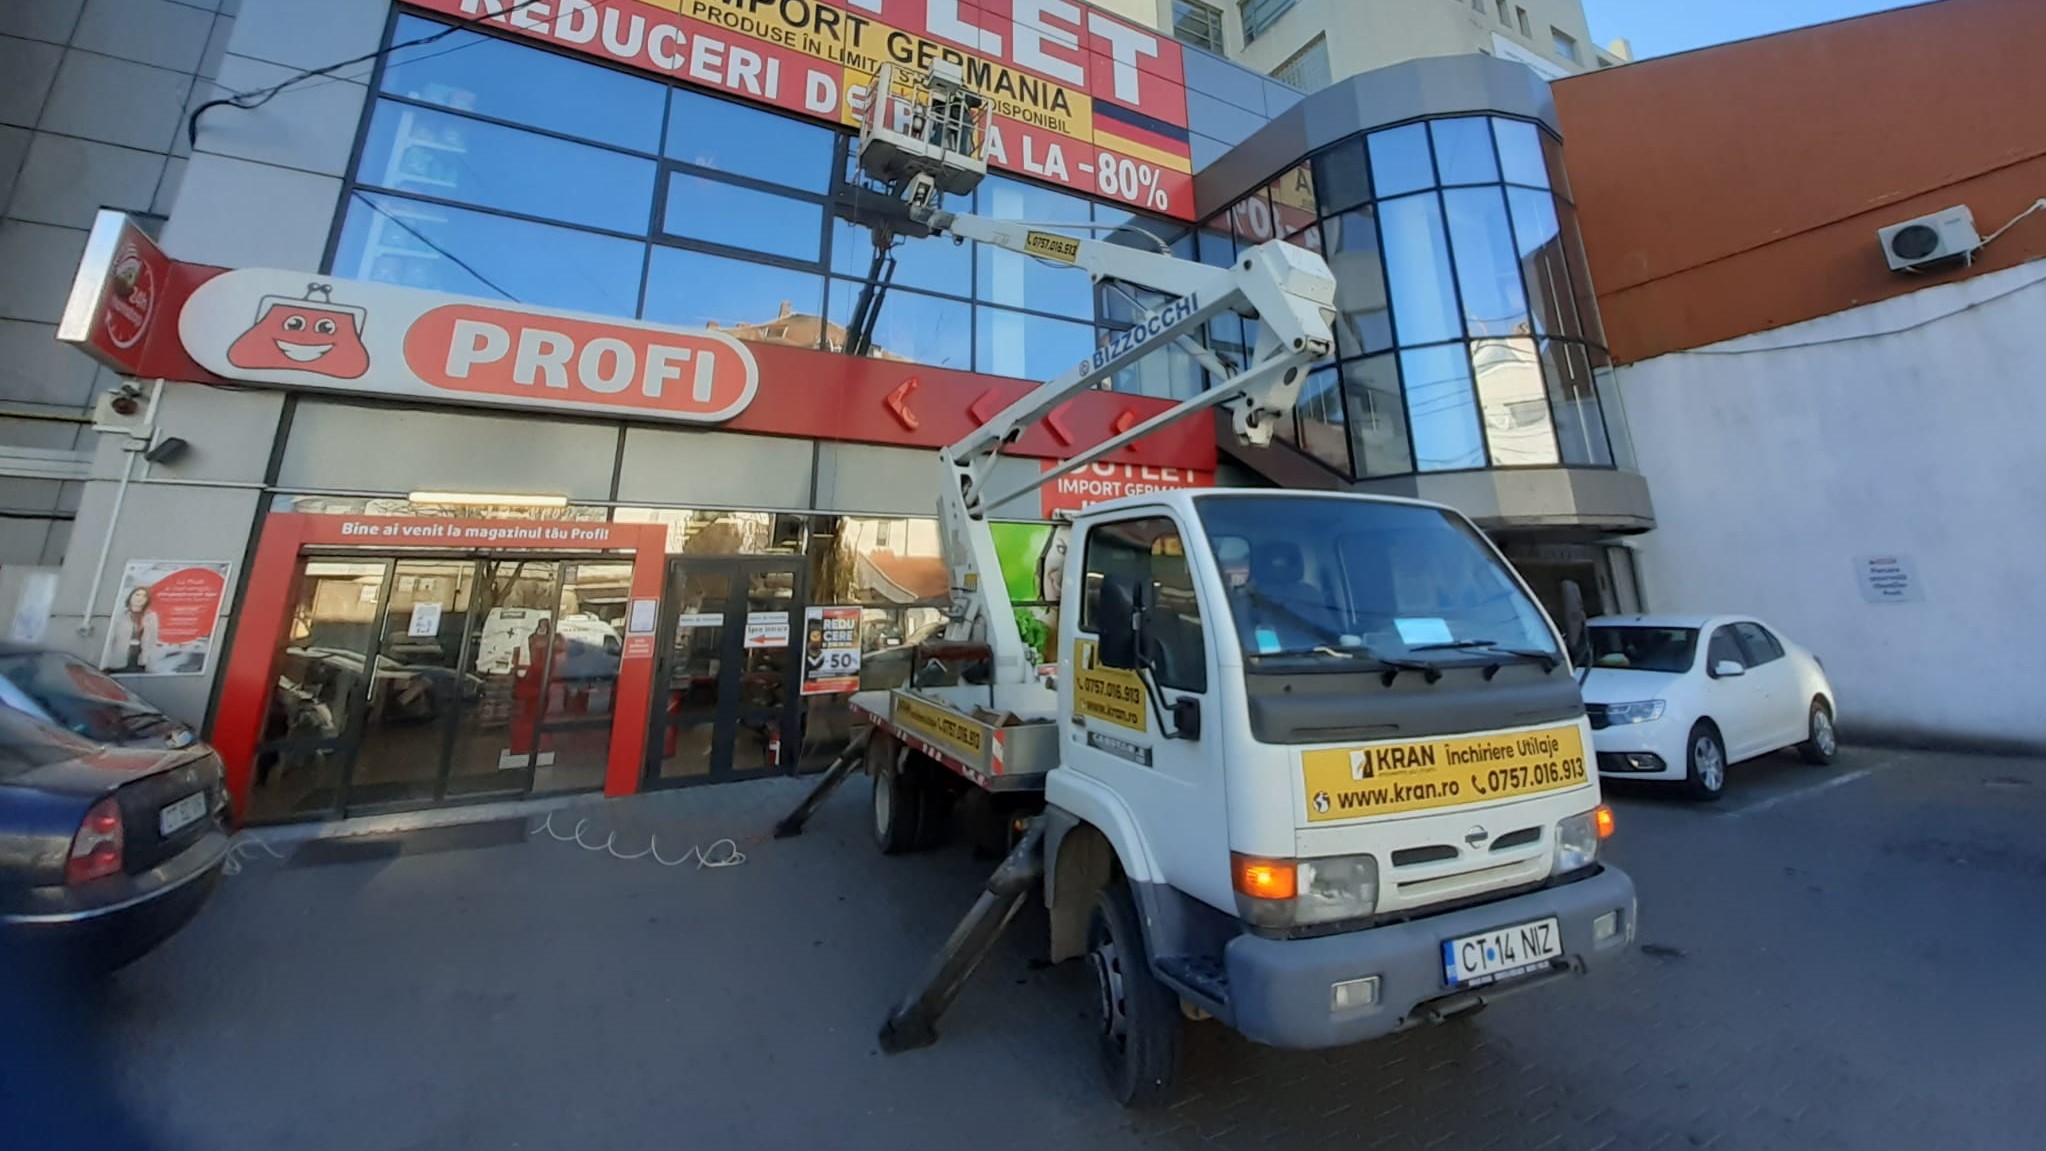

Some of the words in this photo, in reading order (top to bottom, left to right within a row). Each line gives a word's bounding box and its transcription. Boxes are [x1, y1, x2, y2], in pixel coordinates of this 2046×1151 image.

[691, 3, 797, 47] PRODUSE
[802, 33, 822, 56] ÎN
[828, 45, 882, 74] LIMIT
[1022, 134, 1069, 182] LA
[1078, 152, 1169, 212] -80%
[1092, 291, 1199, 370] BIZZOCCHI
[445, 318, 715, 402] PROFI
[1058, 478, 1121, 497] IMPORT
[341, 522, 379, 536] Bine
[383, 523, 399, 536] ai
[403, 523, 445, 538] venit
[447, 524, 461, 538] la
[465, 525, 542, 541] magazinul
[545, 526, 568, 540] tău
[823, 618, 855, 631] REDU
[1376, 744, 1435, 771] KRAN
[1517, 735, 1559, 758] Utilaje
[1337, 779, 1460, 809] www.kran.ro
[1488, 757, 1584, 792] 0757.016.913
[1462, 938, 1487, 972] CT
[1495, 932, 1515, 965] 14
[1521, 923, 1554, 959] NIZ
